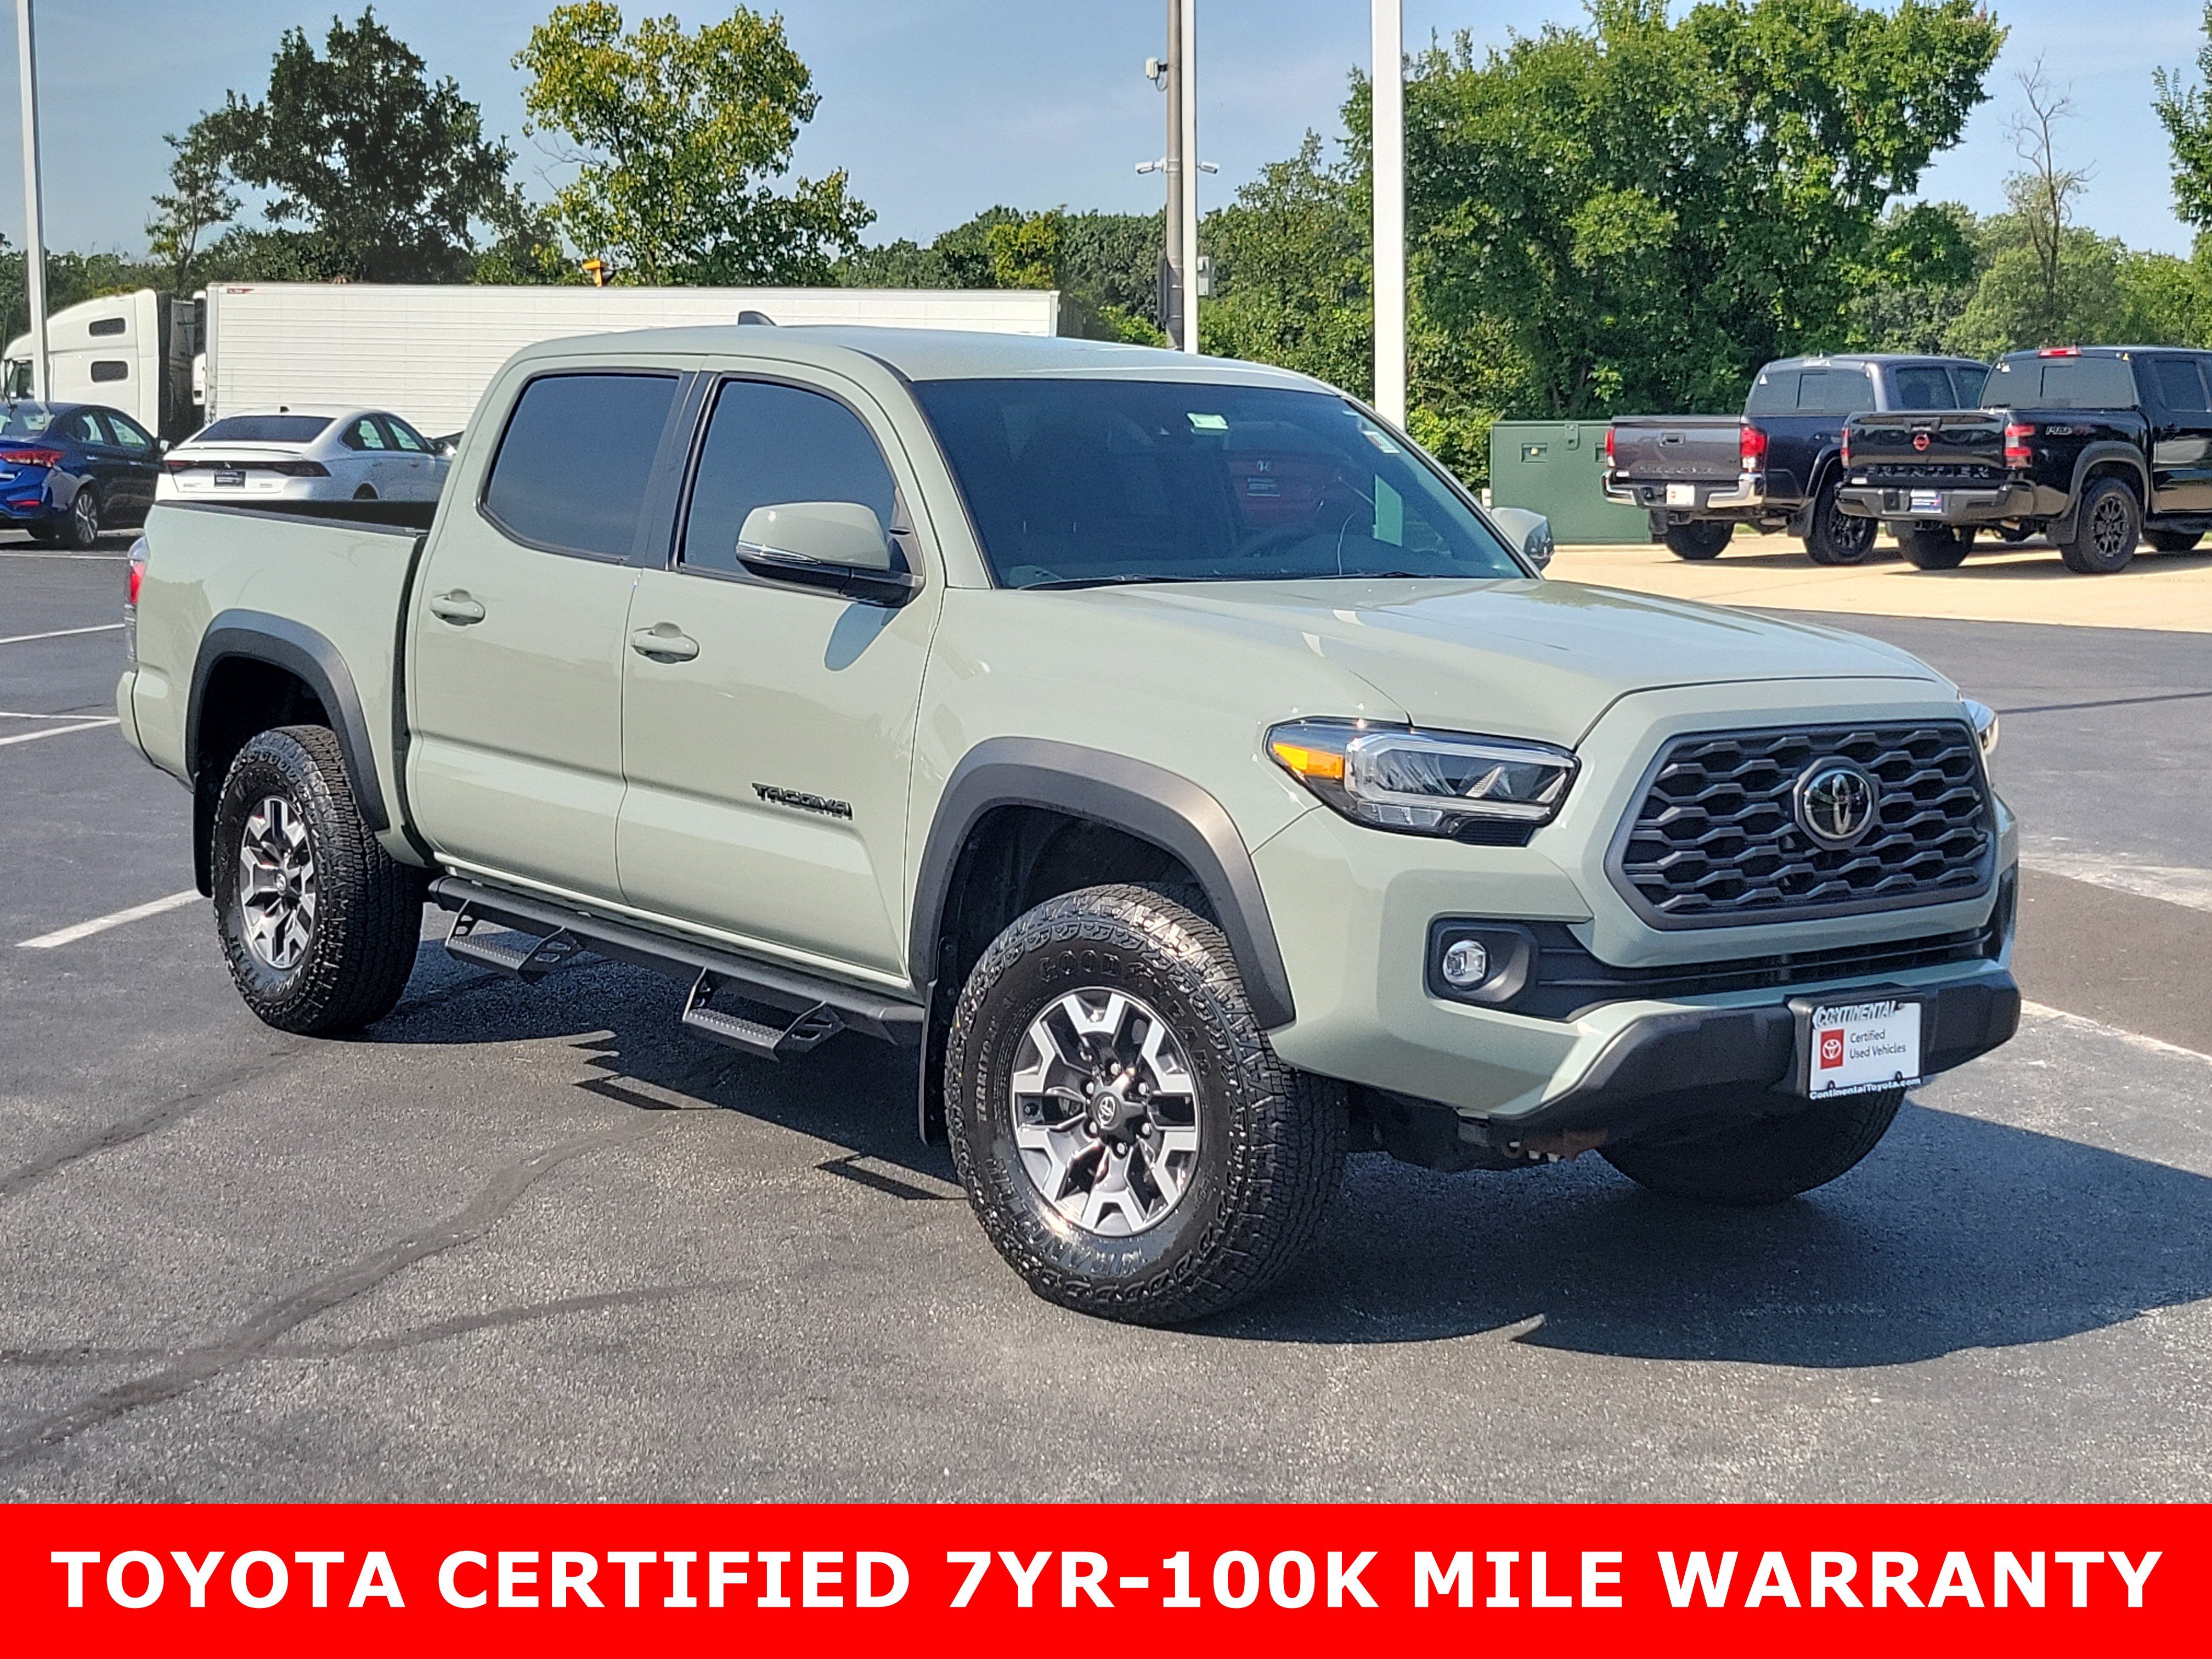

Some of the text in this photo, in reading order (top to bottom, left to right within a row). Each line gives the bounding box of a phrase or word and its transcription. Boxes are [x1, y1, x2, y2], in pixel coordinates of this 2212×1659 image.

[1866, 465, 1990, 478] FRONTIER
[752, 782, 853, 821] TACOMA
[1813, 1001, 1898, 1029] CONTINENTAL
[1850, 1029, 1886, 1043] Certified
[1850, 1043, 1906, 1059] Used Vehicles
[1810, 1078, 1921, 1100] ContinentalToyota.com
